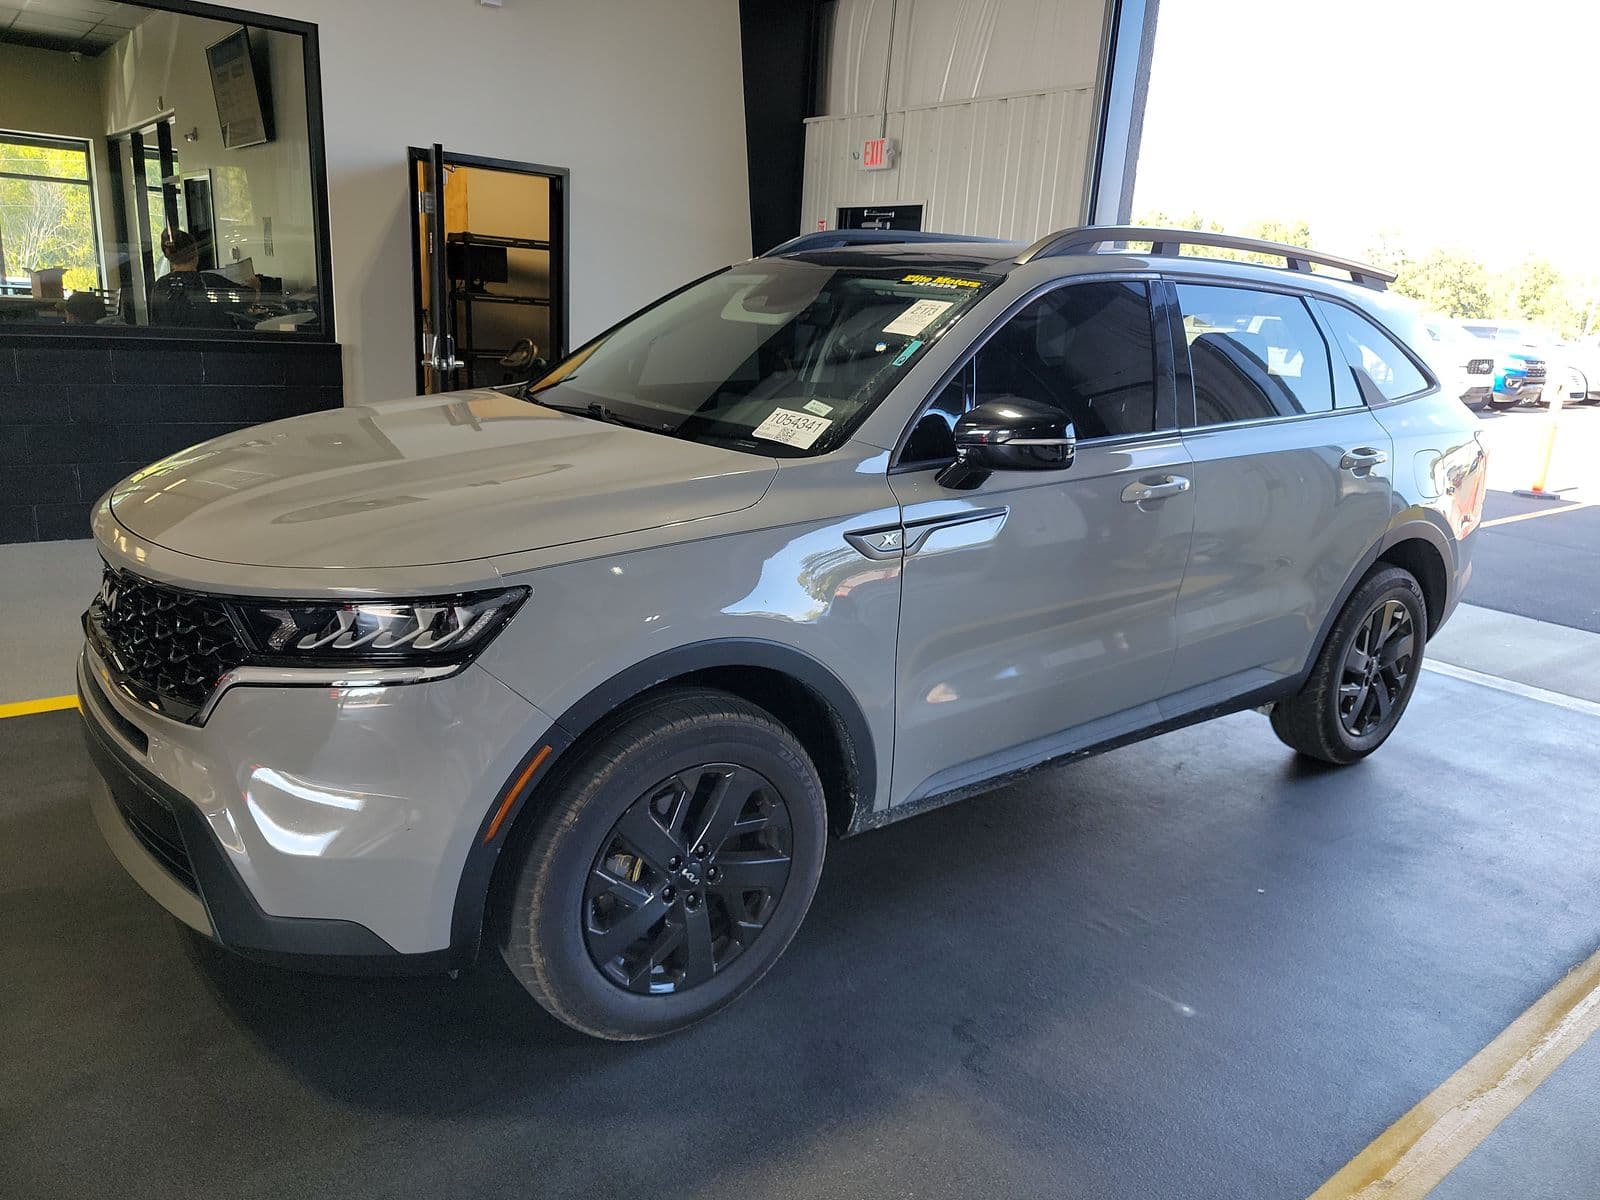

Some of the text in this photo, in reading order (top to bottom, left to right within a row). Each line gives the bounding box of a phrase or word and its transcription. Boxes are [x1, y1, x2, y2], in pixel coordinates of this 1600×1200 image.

[864, 139, 885, 167] EXIT
[902, 274, 981, 288] Elite Motors
[770, 412, 823, 433] 1054341
